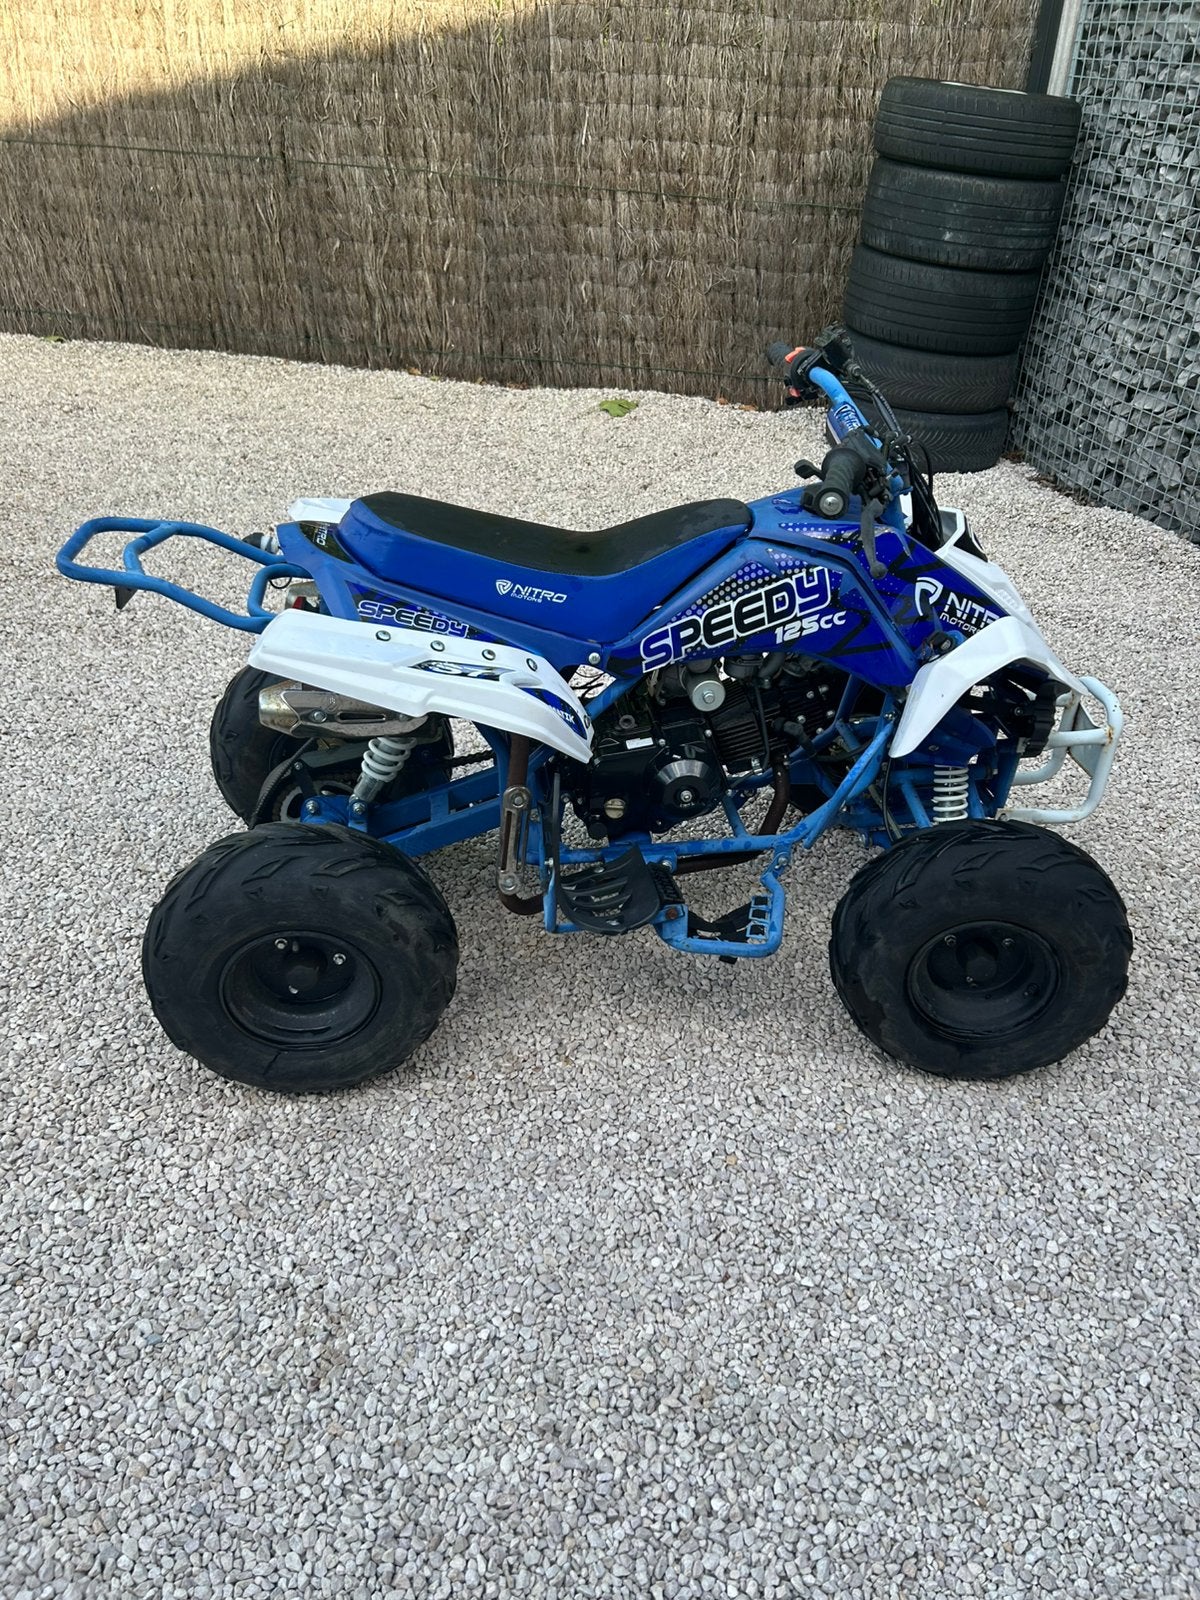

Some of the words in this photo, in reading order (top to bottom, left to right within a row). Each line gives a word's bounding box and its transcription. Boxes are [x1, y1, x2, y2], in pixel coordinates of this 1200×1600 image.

[513, 584, 567, 603] NITRO
[944, 591, 1001, 629] NITR
[357, 600, 470, 639] SPEEDY
[640, 566, 831, 673] SPEEDY
[774, 611, 847, 645] 125cc
[940, 612, 982, 633] MOTOR
